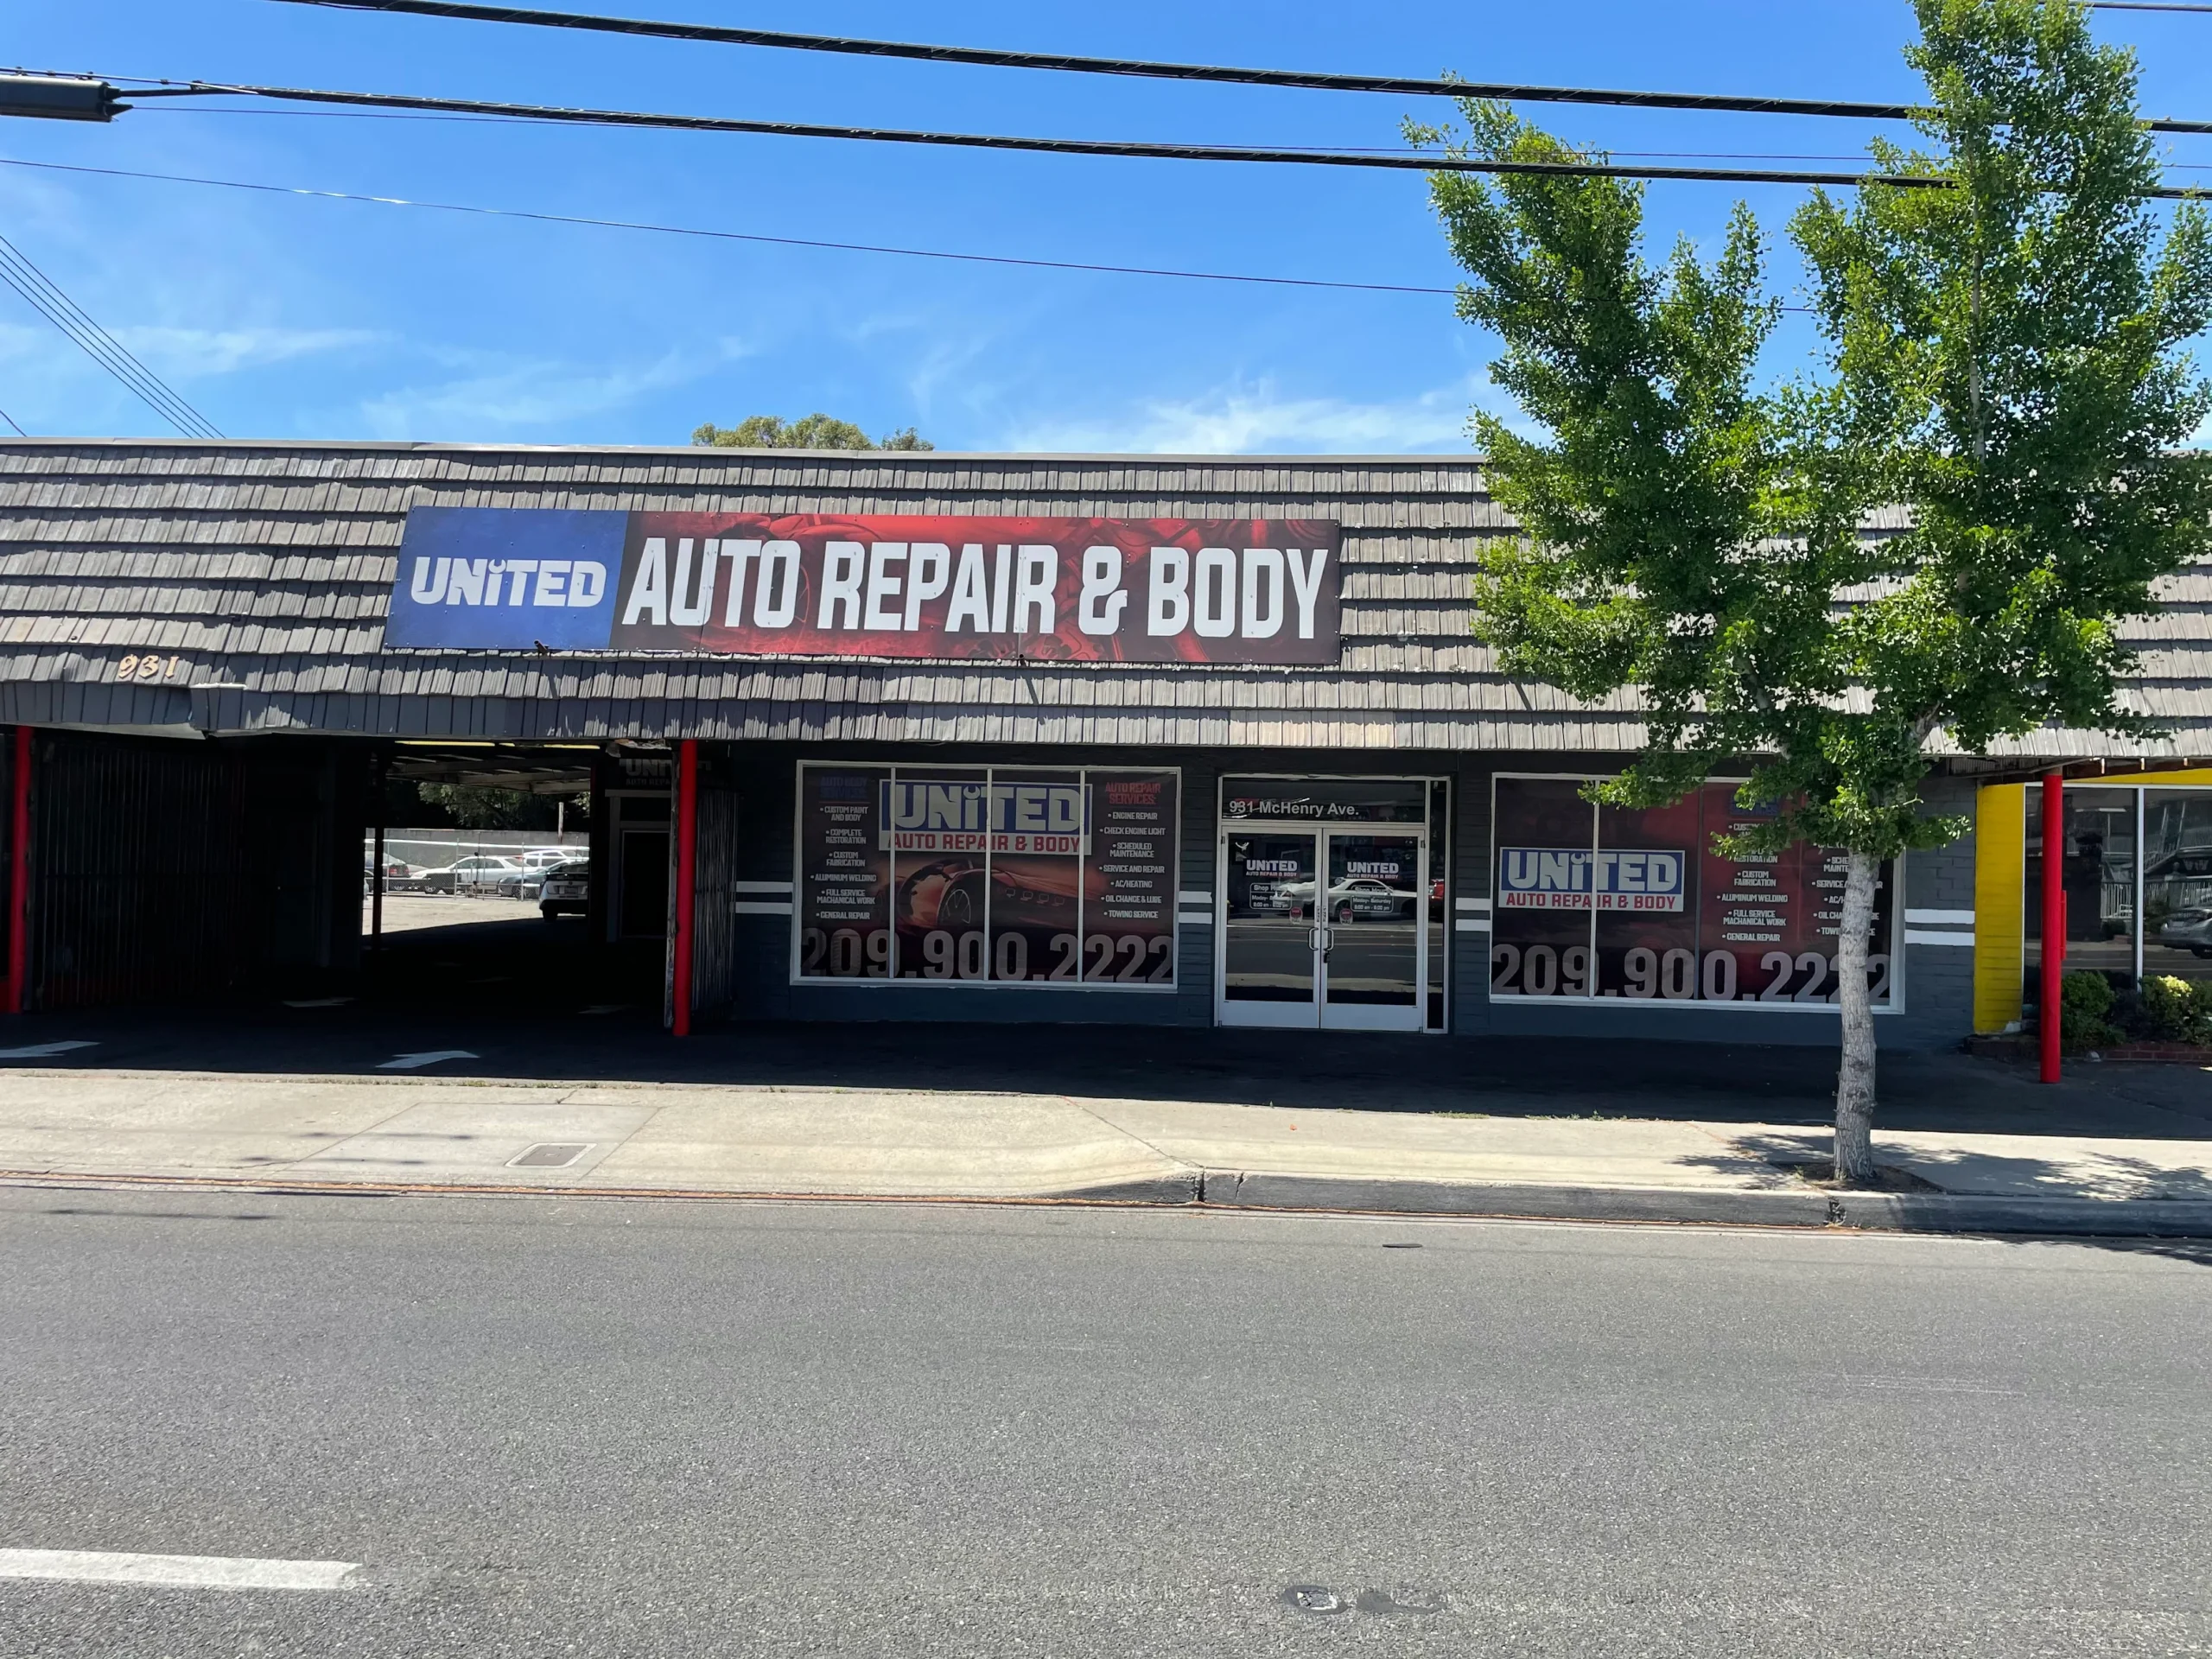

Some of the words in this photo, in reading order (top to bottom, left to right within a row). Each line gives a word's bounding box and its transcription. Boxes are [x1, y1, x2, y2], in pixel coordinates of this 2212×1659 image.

[621, 537, 802, 628] AUTO
[817, 541, 1058, 634] REPAIR
[1078, 545, 1128, 635] &
[1147, 546, 1329, 639] BODY
[118, 653, 180, 679] 931
[1229, 801, 1253, 813] 931
[1259, 802, 1324, 817] McHenry
[1326, 803, 1359, 816] Ave.
[888, 833, 936, 849] AUTO
[943, 834, 1008, 851] REPAIR
[1015, 836, 1027, 851] &
[1033, 836, 1081, 853] BODY
[1109, 849, 1155, 858] MAINTENANCE
[1142, 865, 1166, 874] REPAIR
[1733, 878, 1777, 887] FABRICATION
[1506, 893, 1546, 906] AUTO
[1552, 893, 1612, 908] REPAIR
[1618, 895, 1629, 908] &
[1633, 896, 1676, 909] BODY
[1721, 893, 1758, 902] ALUMINUM
[1765, 918, 1786, 926] WORK
[801, 928, 1173, 983] 209.900.2222
